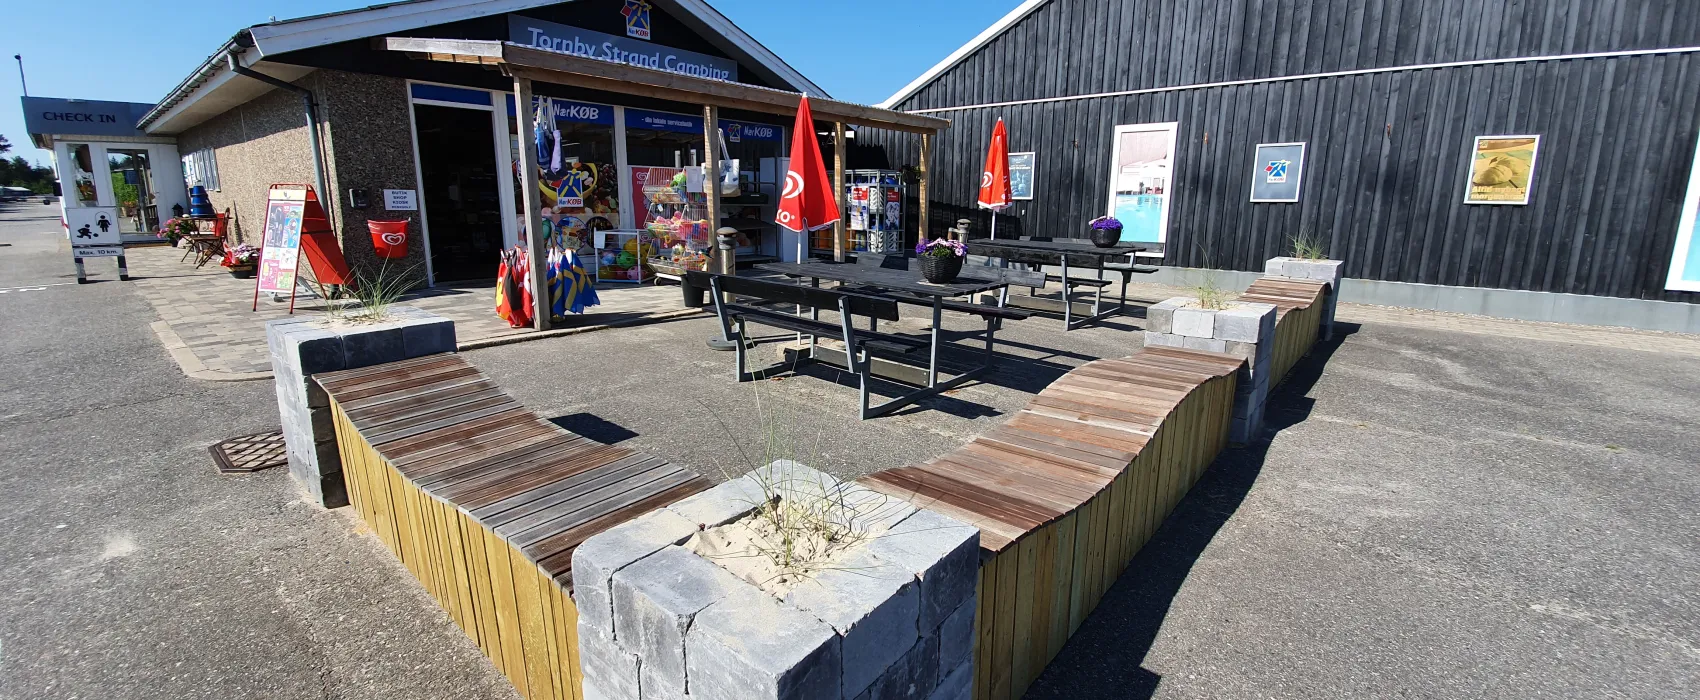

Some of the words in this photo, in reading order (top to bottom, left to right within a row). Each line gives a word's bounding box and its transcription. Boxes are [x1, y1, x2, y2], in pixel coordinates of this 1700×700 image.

[528, 27, 596, 57] Tornby
[602, 42, 660, 69] Strand
[664, 55, 729, 80] Camping
[43, 111, 93, 123] CHECK
[98, 114, 116, 123] IN
[553, 103, 599, 119] NærKØB
